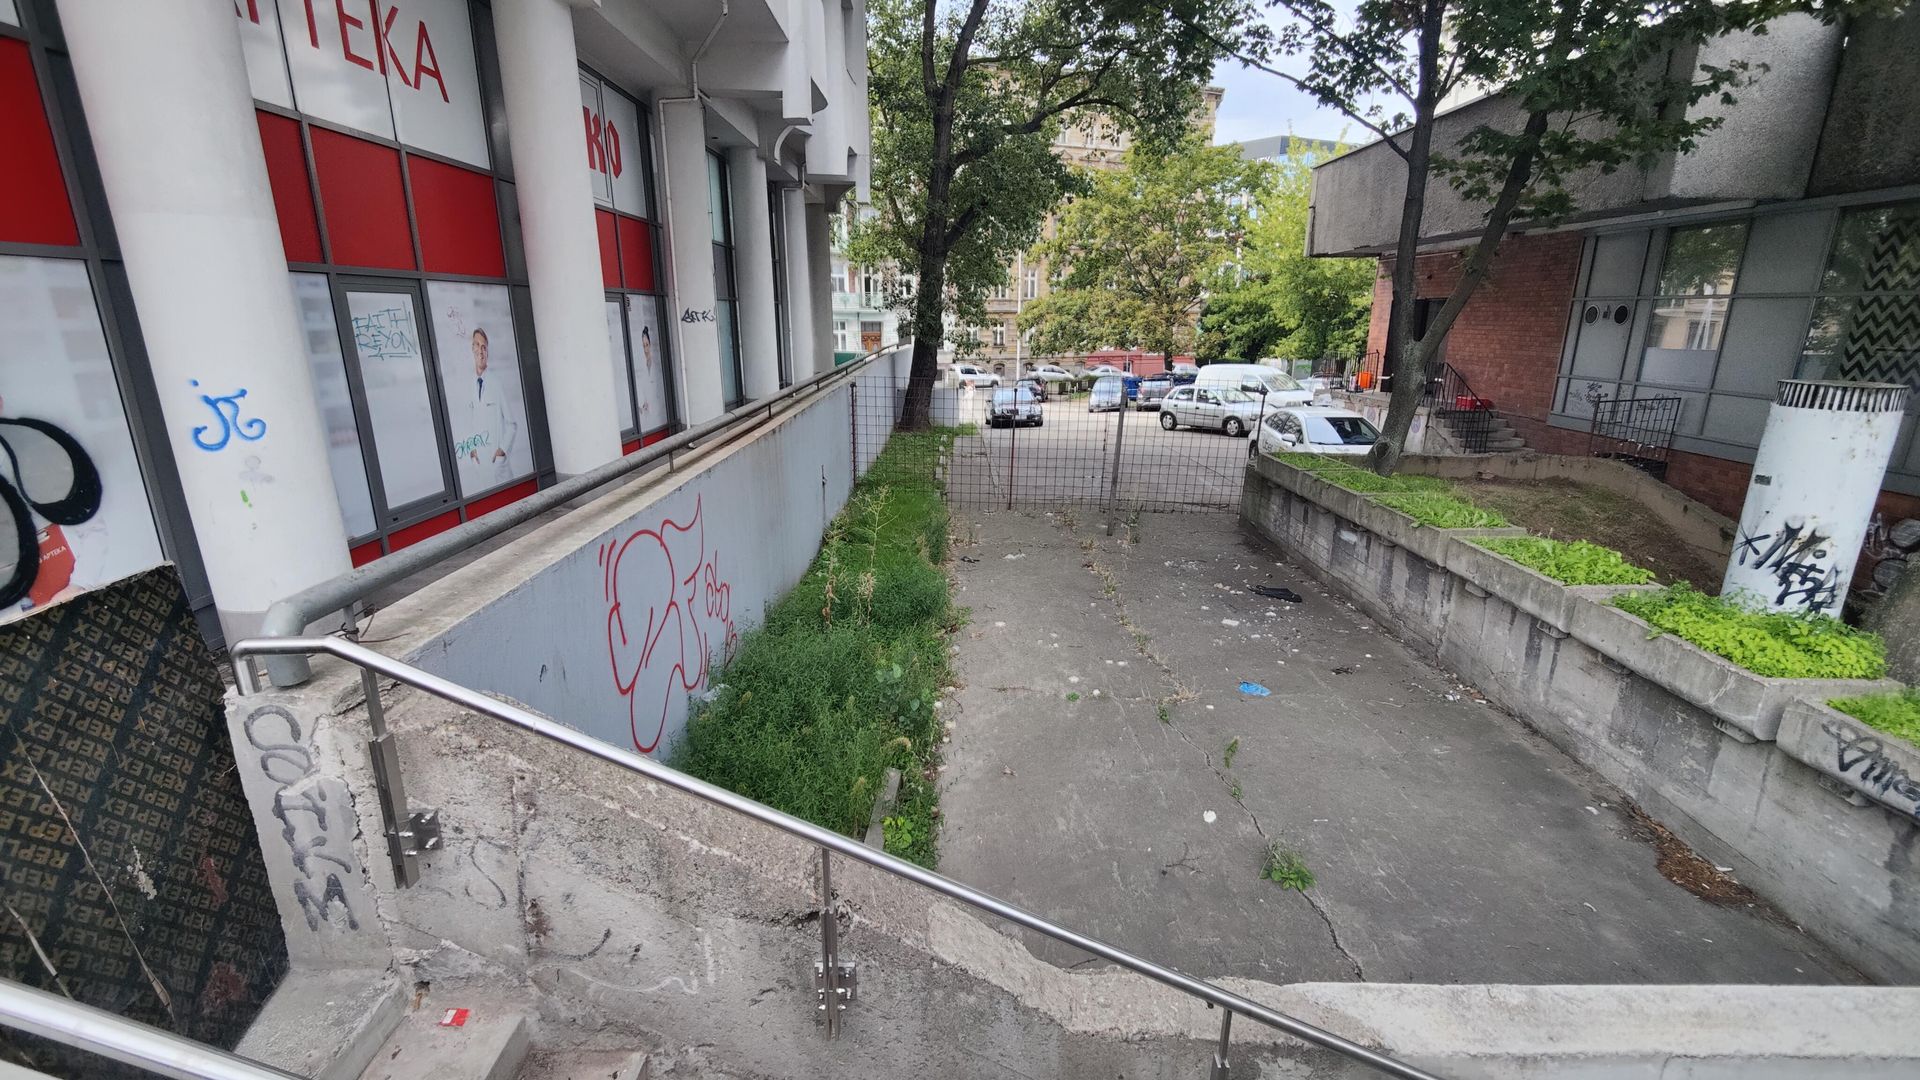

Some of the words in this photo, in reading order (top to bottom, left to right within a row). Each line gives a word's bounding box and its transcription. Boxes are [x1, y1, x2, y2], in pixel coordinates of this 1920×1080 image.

[63, 637, 142, 686] REPLEX
[72, 618, 149, 668] REPLEX
[53, 656, 133, 704] REPLEX
[22, 717, 110, 762] REPLEX
[33, 696, 117, 742] REPLEX
[108, 773, 179, 812] REPLEX
[119, 753, 187, 793] REPLEX
[0, 809, 80, 846] REPLE
